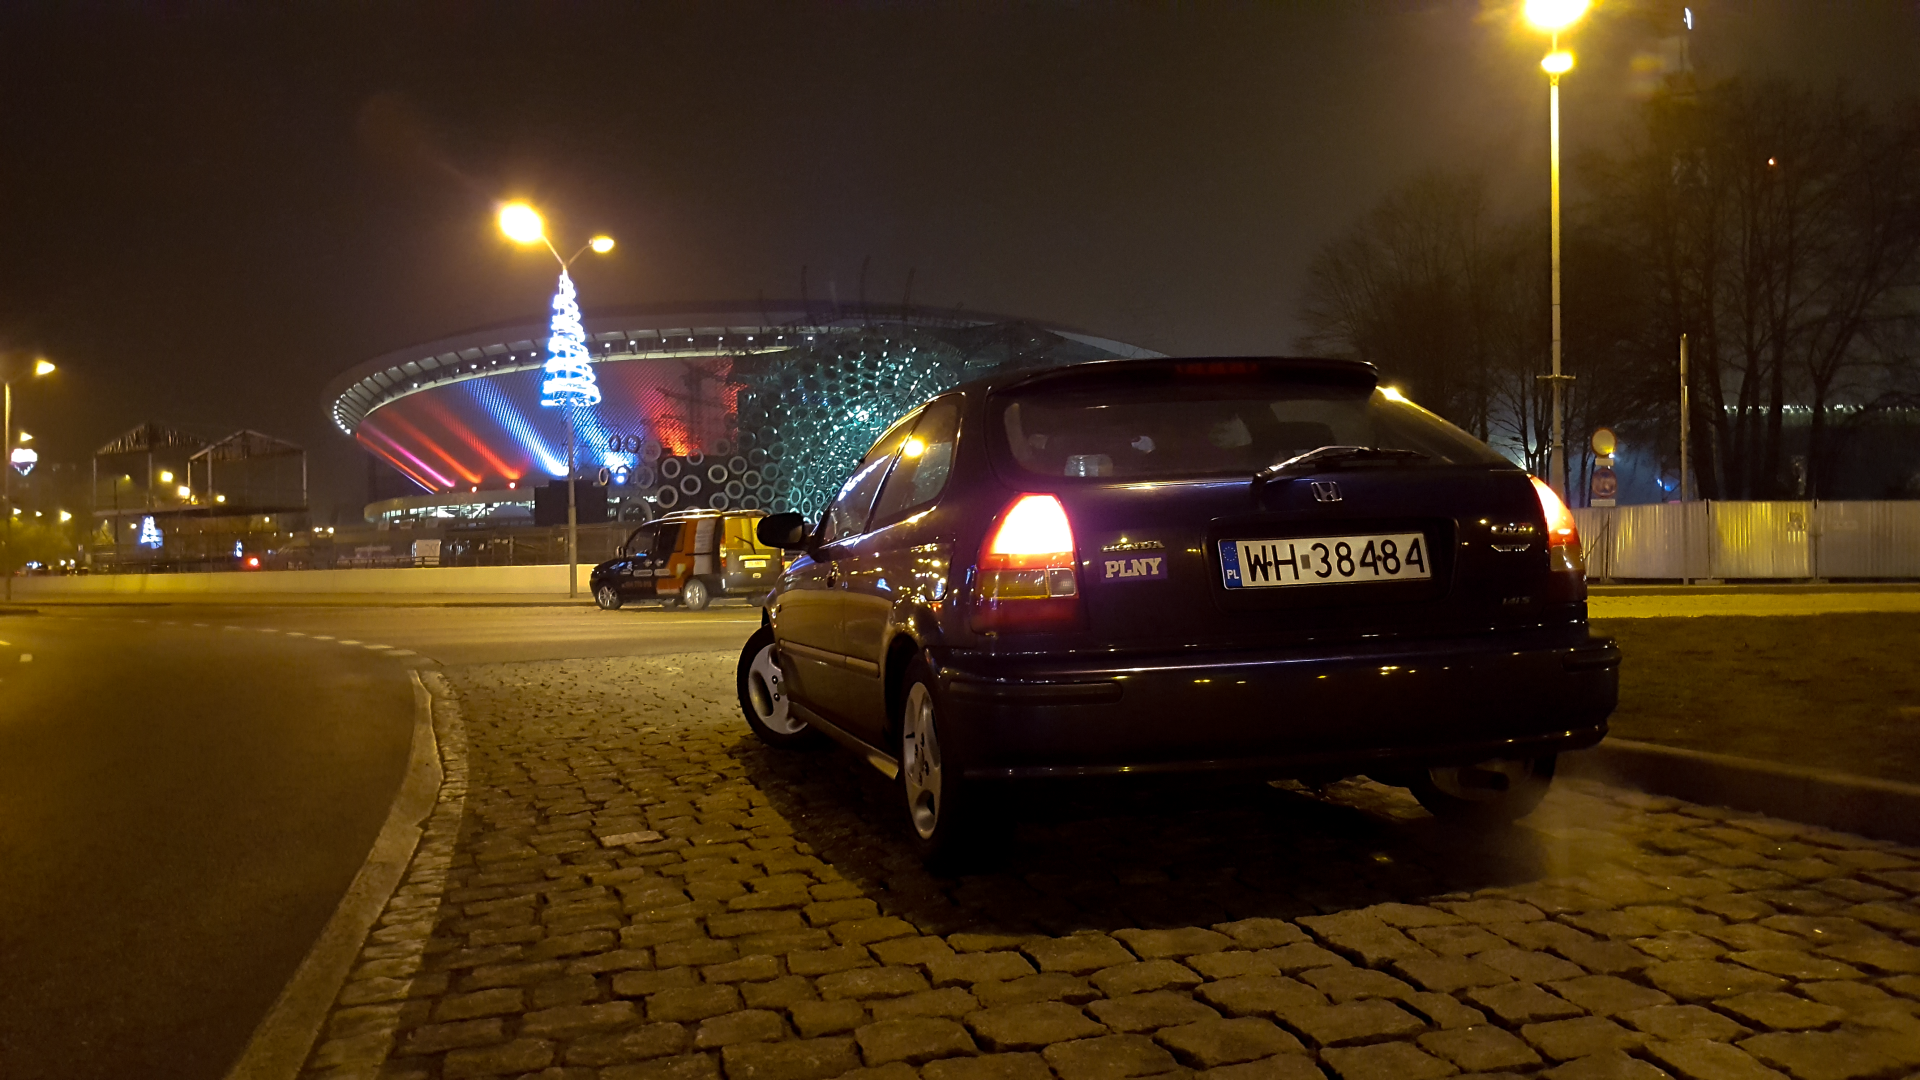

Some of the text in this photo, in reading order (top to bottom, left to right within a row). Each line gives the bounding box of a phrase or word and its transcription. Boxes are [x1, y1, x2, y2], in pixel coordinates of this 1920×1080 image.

[1101, 540, 1165, 552] HONDA
[1105, 557, 1162, 578] PLNY
[1244, 537, 1425, 582] WH 38484
[1226, 569, 1240, 580] PL
